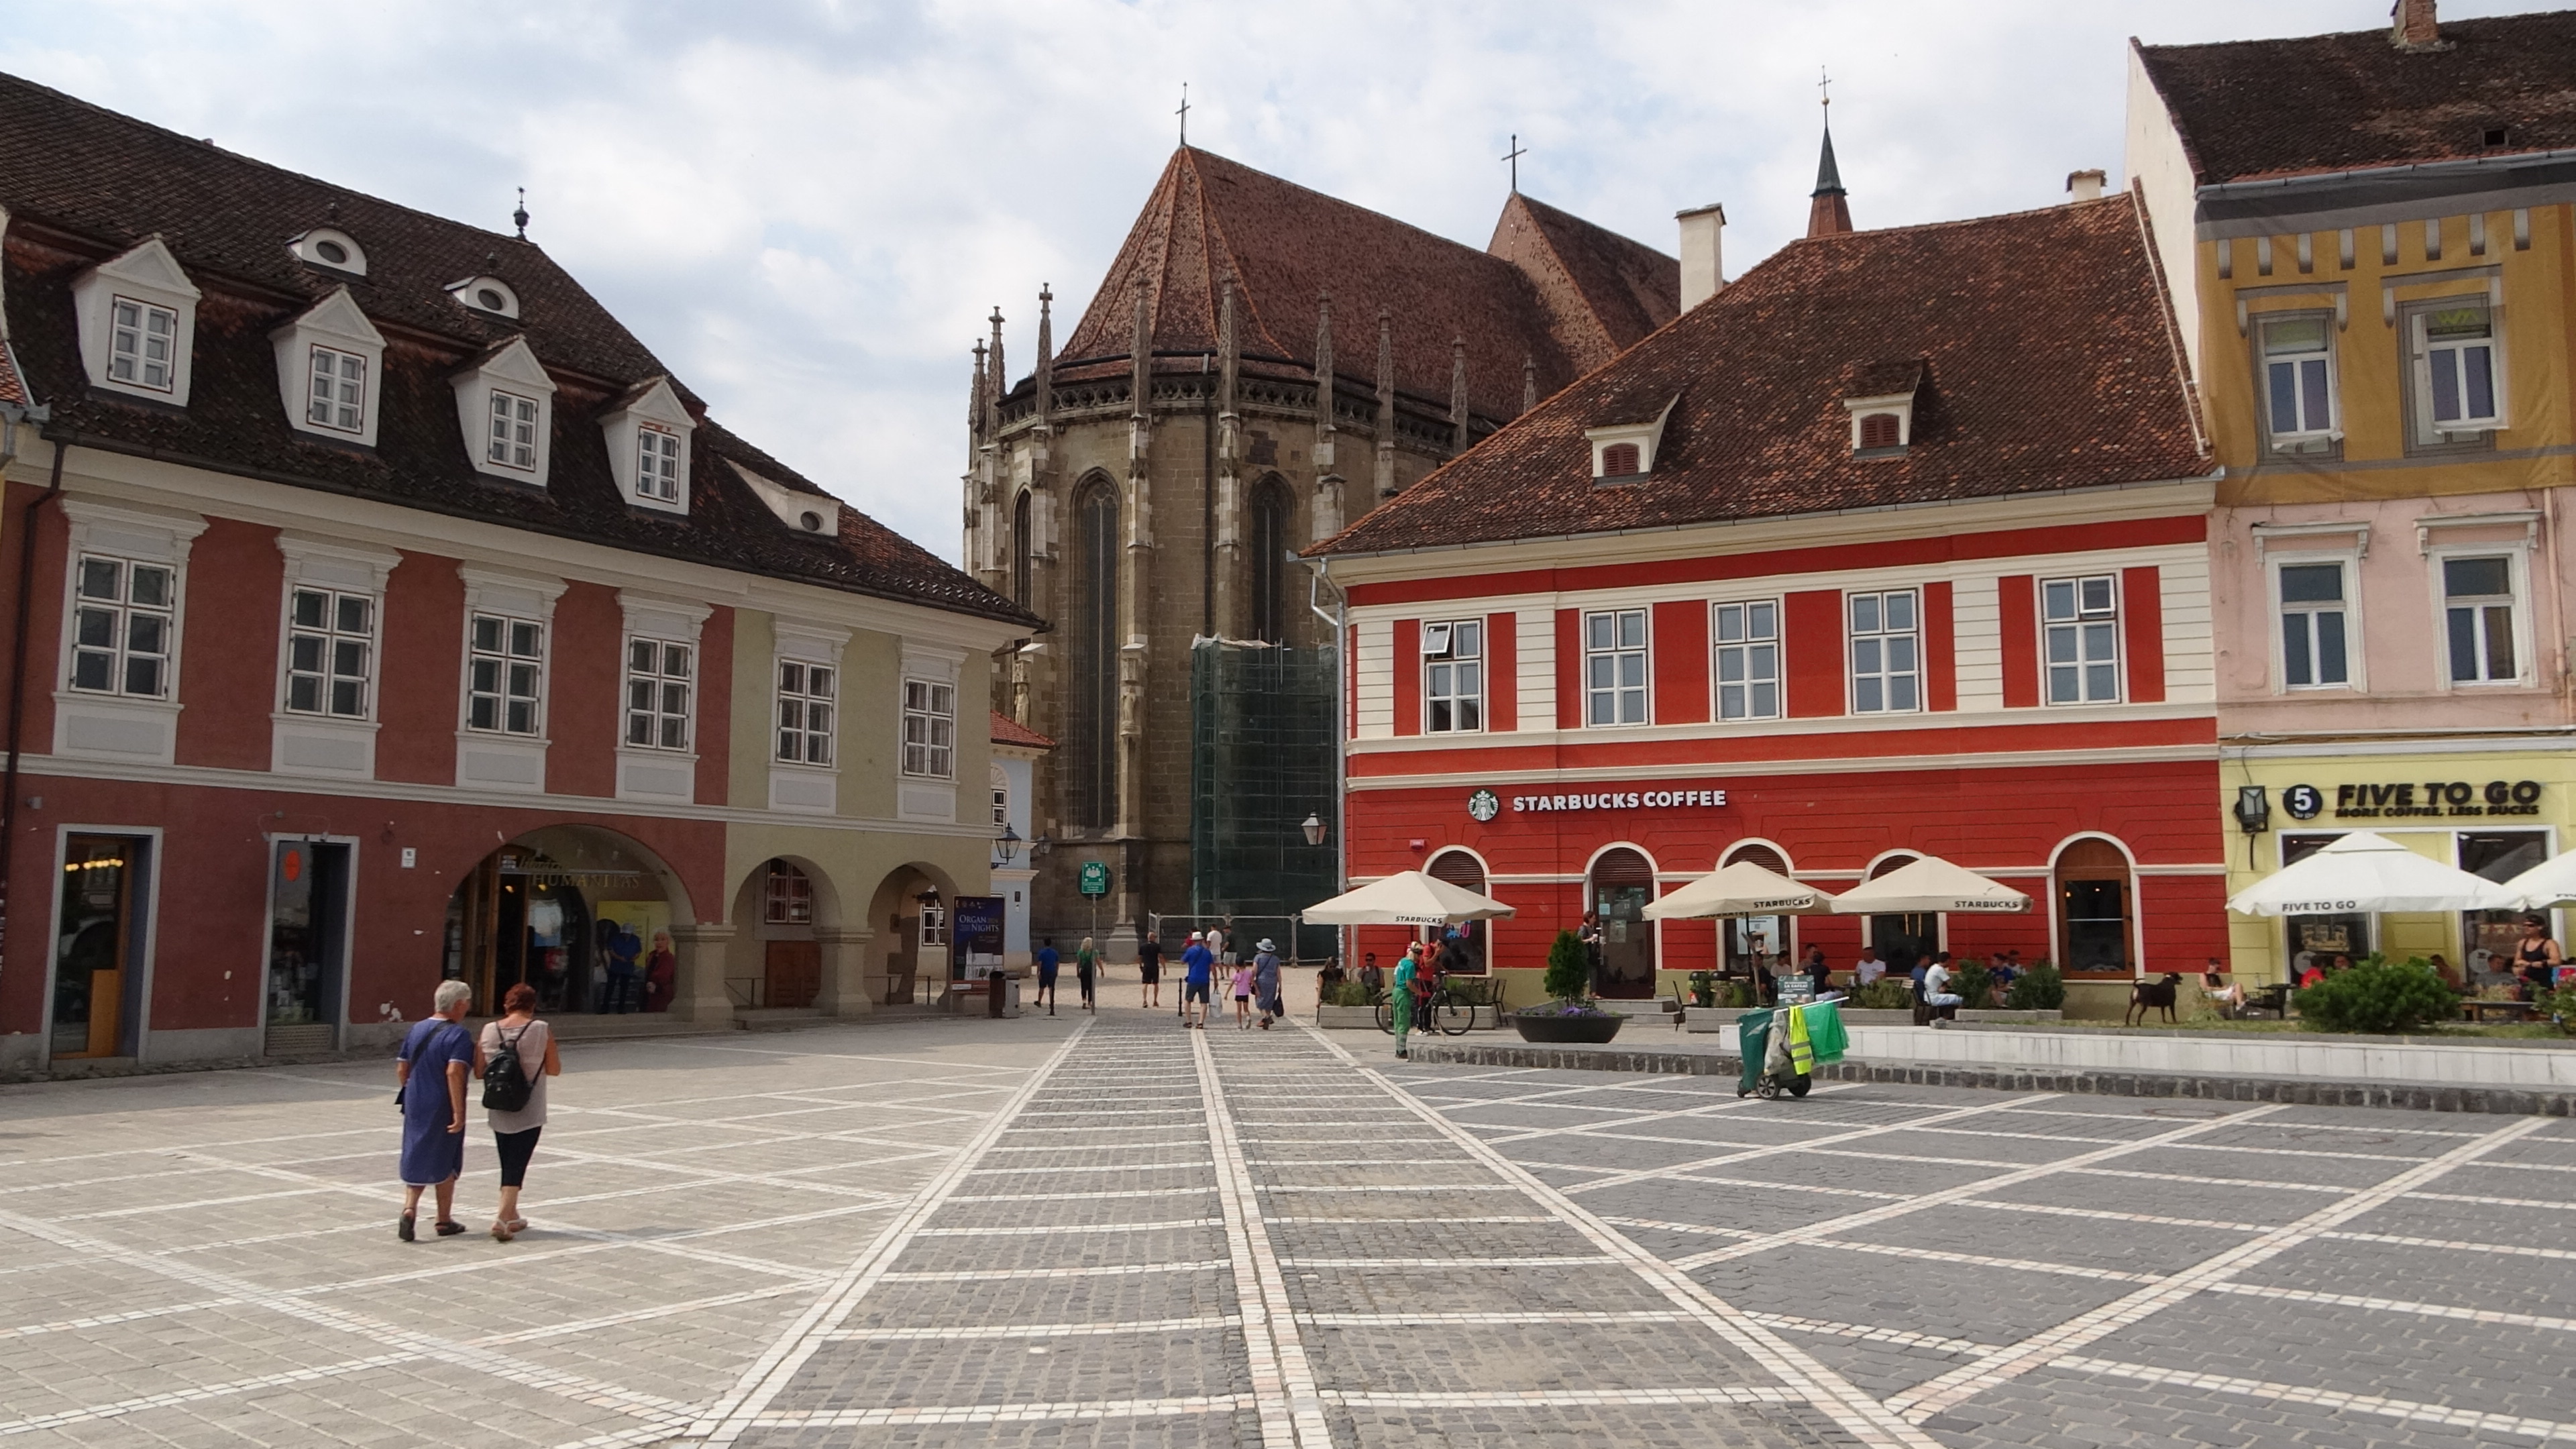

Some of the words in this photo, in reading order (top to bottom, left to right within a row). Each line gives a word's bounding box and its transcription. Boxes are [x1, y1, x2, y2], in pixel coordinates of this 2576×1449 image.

[2337, 784, 2414, 806] FIVE
[2424, 782, 2473, 805] TO
[2485, 780, 2541, 804] GO
[1513, 792, 1640, 812] STARBUCKS
[1643, 790, 1726, 807] COFFEE
[2294, 788, 2312, 811] 5
[2335, 808, 2381, 818] MORE
[2449, 806, 2483, 816] LESS
[532, 873, 639, 888] HUMANITAS
[1754, 898, 1811, 908] STARBUCKS
[1955, 900, 2019, 908] STARBUCKS
[2282, 902, 2310, 912] FIVE
[2314, 902, 2332, 911] TO
[2336, 900, 2356, 910] GO
[959, 914, 987, 924] ORGAN
[1395, 916, 1442, 924] STARBUCKS
[971, 923, 999, 932] NIGHTS
